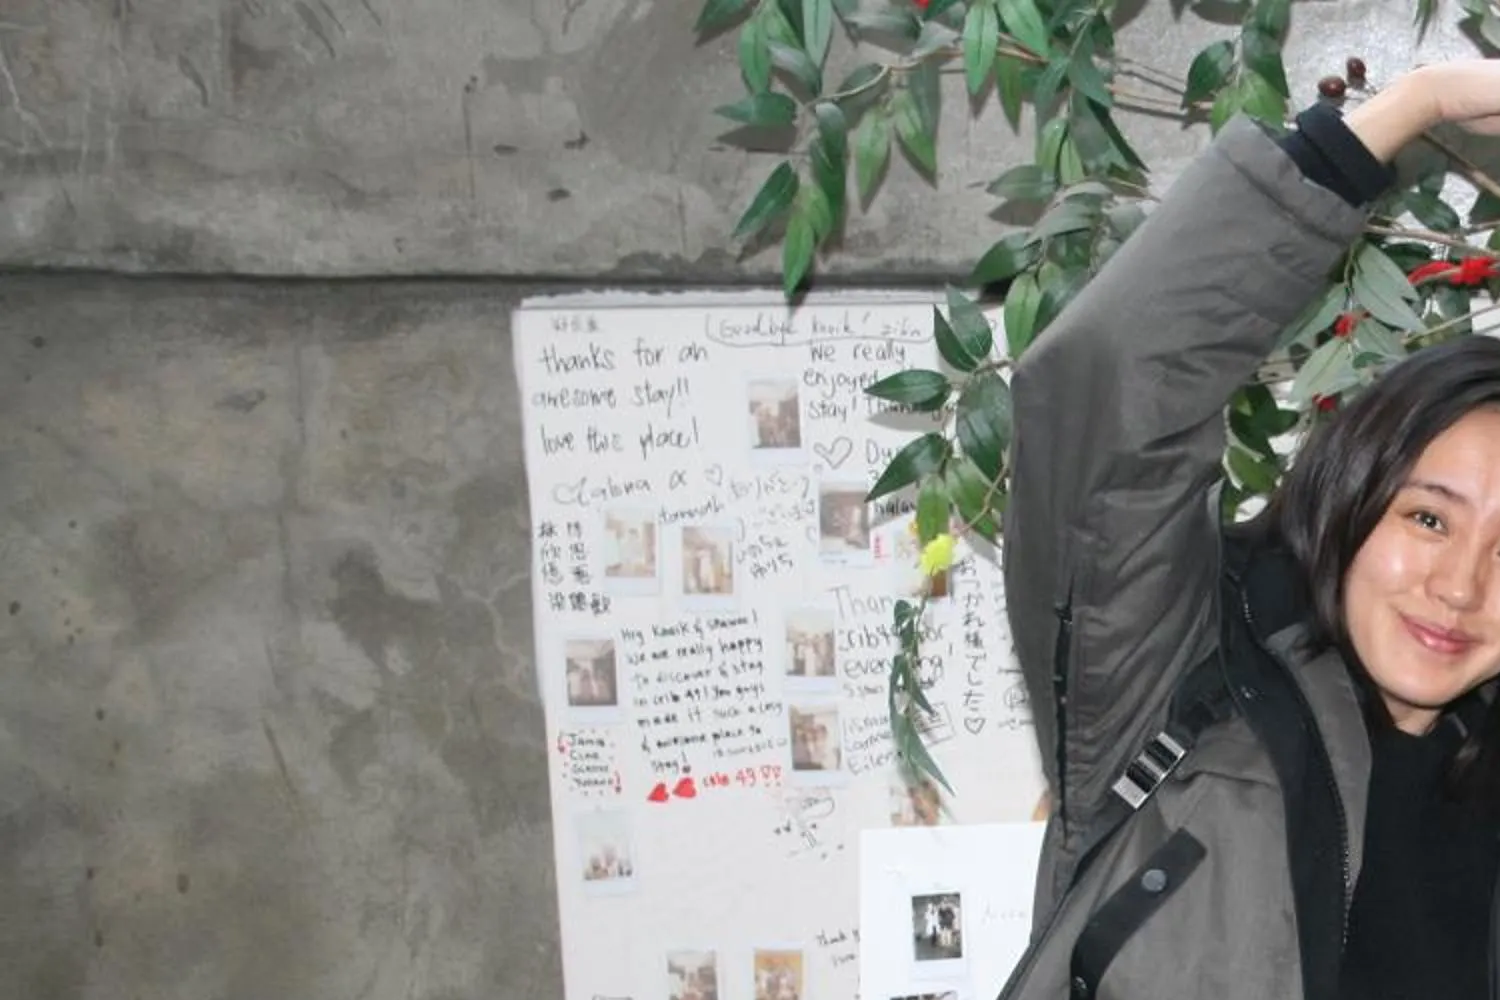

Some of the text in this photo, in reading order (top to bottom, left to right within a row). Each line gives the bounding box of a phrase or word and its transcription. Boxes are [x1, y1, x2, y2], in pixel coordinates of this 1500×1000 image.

[537, 336, 710, 373] thanks for an
[811, 338, 905, 364] We really
[541, 423, 575, 457] love
[639, 416, 701, 461] place!
